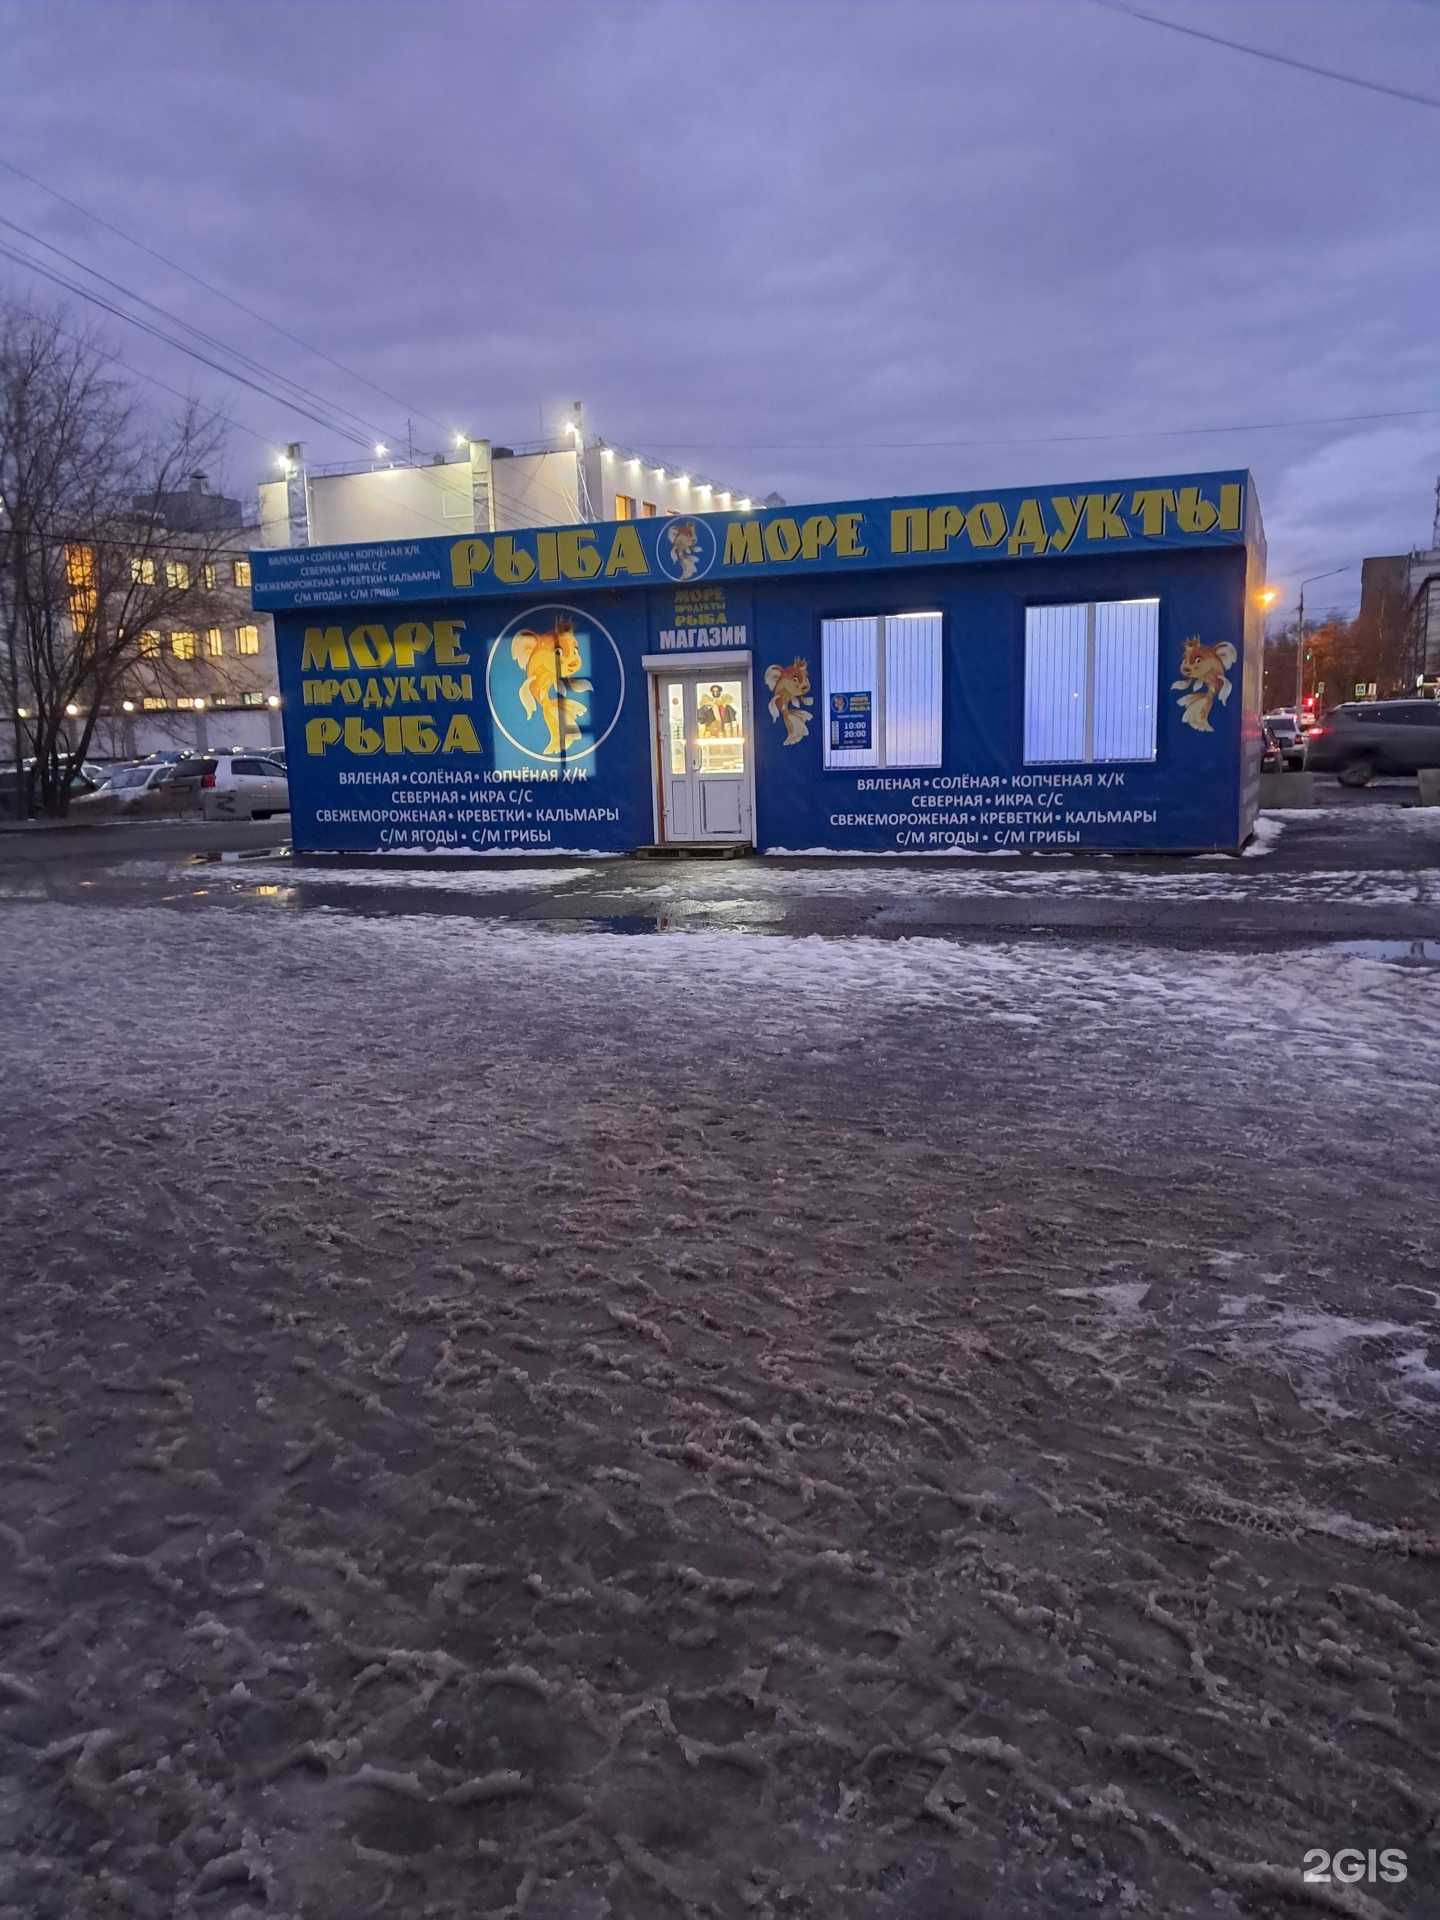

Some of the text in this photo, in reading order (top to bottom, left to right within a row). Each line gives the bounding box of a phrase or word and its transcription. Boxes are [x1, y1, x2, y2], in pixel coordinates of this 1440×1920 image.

[450, 483, 1244, 588] РЫБА МОРЕ ПРОДУКТЫ
[389, 570, 441, 583] КАЛЬМАРЫ
[675, 613, 727, 626] РЫБА
[660, 625, 747, 649] МАГАЗИН
[301, 620, 470, 672] МОРЕ
[303, 674, 473, 710] ПРОДУКТЫ
[843, 730, 866, 738] 20:00
[844, 722, 866, 730] 10:00
[305, 714, 483, 756] РЫБА
[339, 766, 587, 785] ВЯЛЕНАЯ СОЛЁНАЯ КОПЧЁНАЯ Х/К
[857, 772, 1125, 791] ВЯЛЕНАЯ СОЛЁНАЯ КОПЧЕНАЯ Х/К
[391, 789, 534, 805] СЕВЕРНАЯ ИКРА С/С
[911, 792, 1064, 808] СЕВЕРНАЯ ИКРА С/С
[316, 807, 619, 823] СВЕЖЕМОРОЖЕНАЯ КРЕВЕТКИ КАЛЬМАРЫ
[830, 810, 1157, 826] СВЕЖЕМОРОЖЕНАЯ КРЕВЕТКИ КАЛЬМАРЫ
[380, 828, 551, 845] С/М ЯГОДЫ С/М ГРИБЫ
[896, 830, 1081, 846] С/М ЯГОДЫ С/М ГРИБЫ
